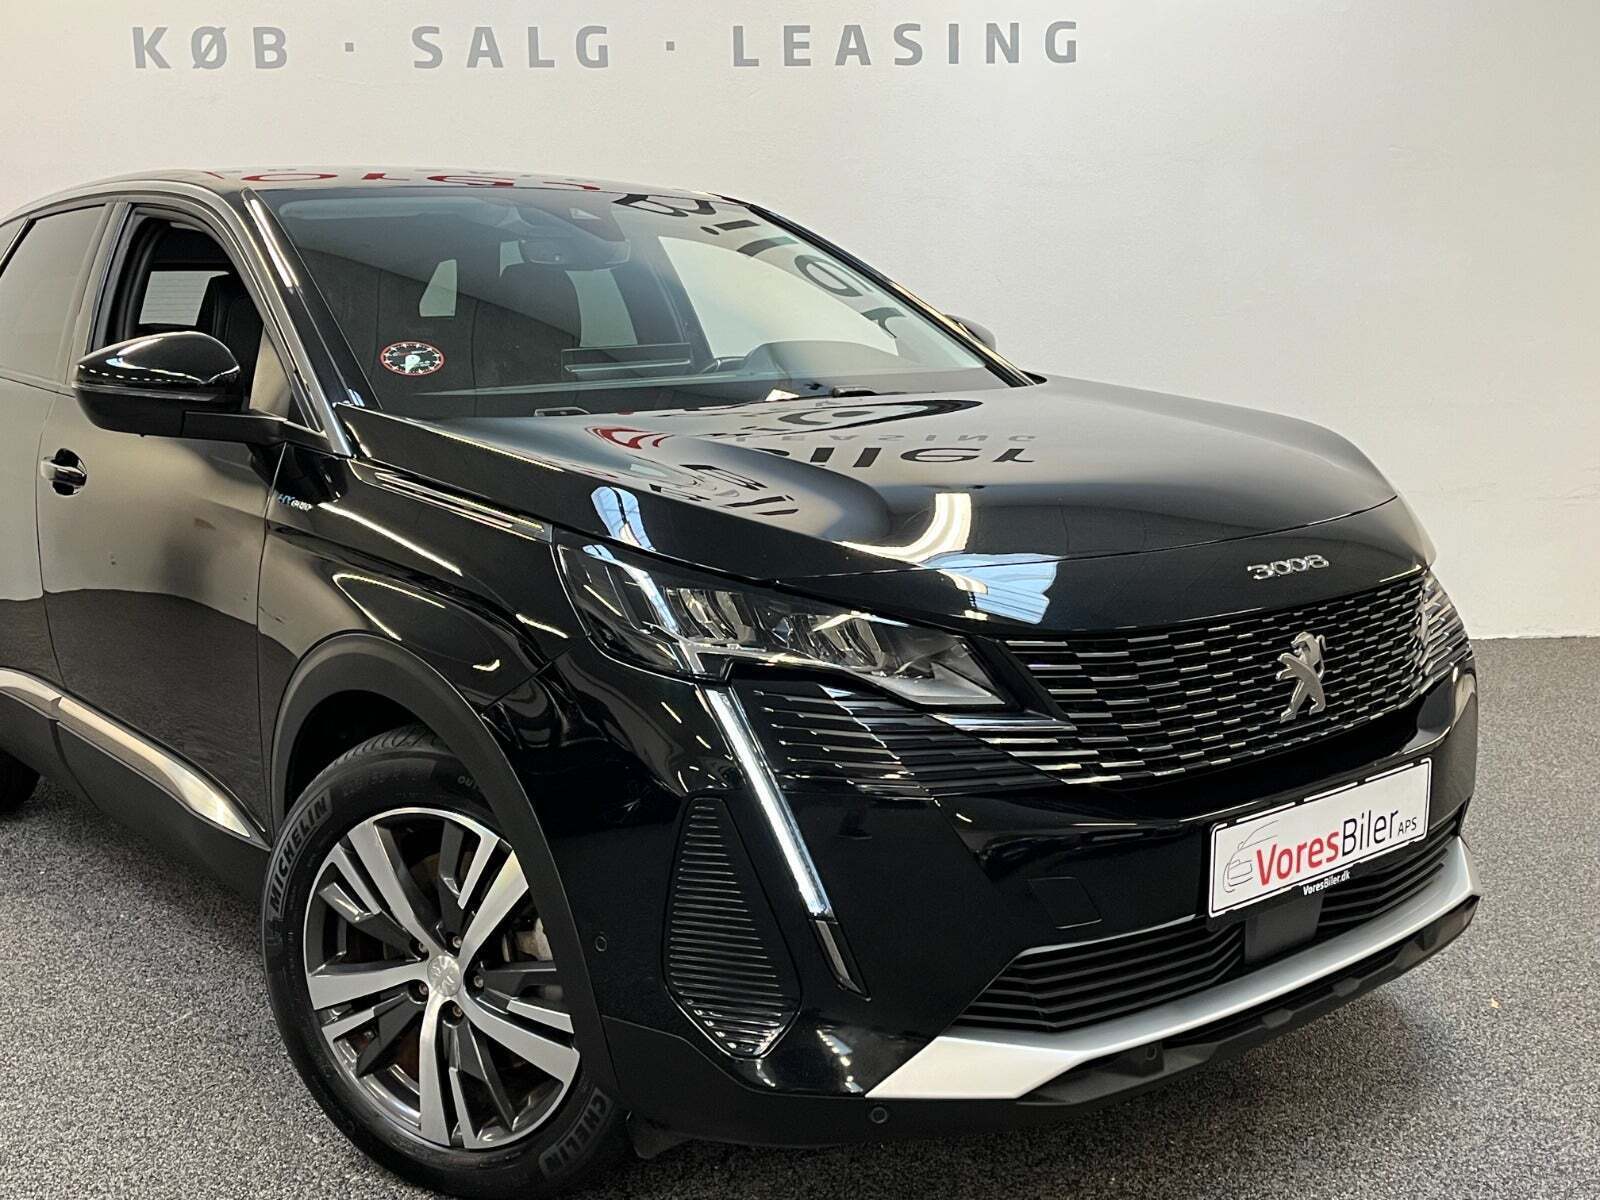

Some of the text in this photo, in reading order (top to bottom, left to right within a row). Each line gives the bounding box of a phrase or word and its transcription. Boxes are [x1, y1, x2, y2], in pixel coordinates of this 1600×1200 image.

[132, 20, 1078, 70] KØB SALG LEASING
[1246, 554, 1330, 580] 3008
[268, 796, 328, 914] MICHELIN
[1256, 809, 1418, 887] VoresBiler APS
[1302, 869, 1351, 896] VoresBiler.dk
